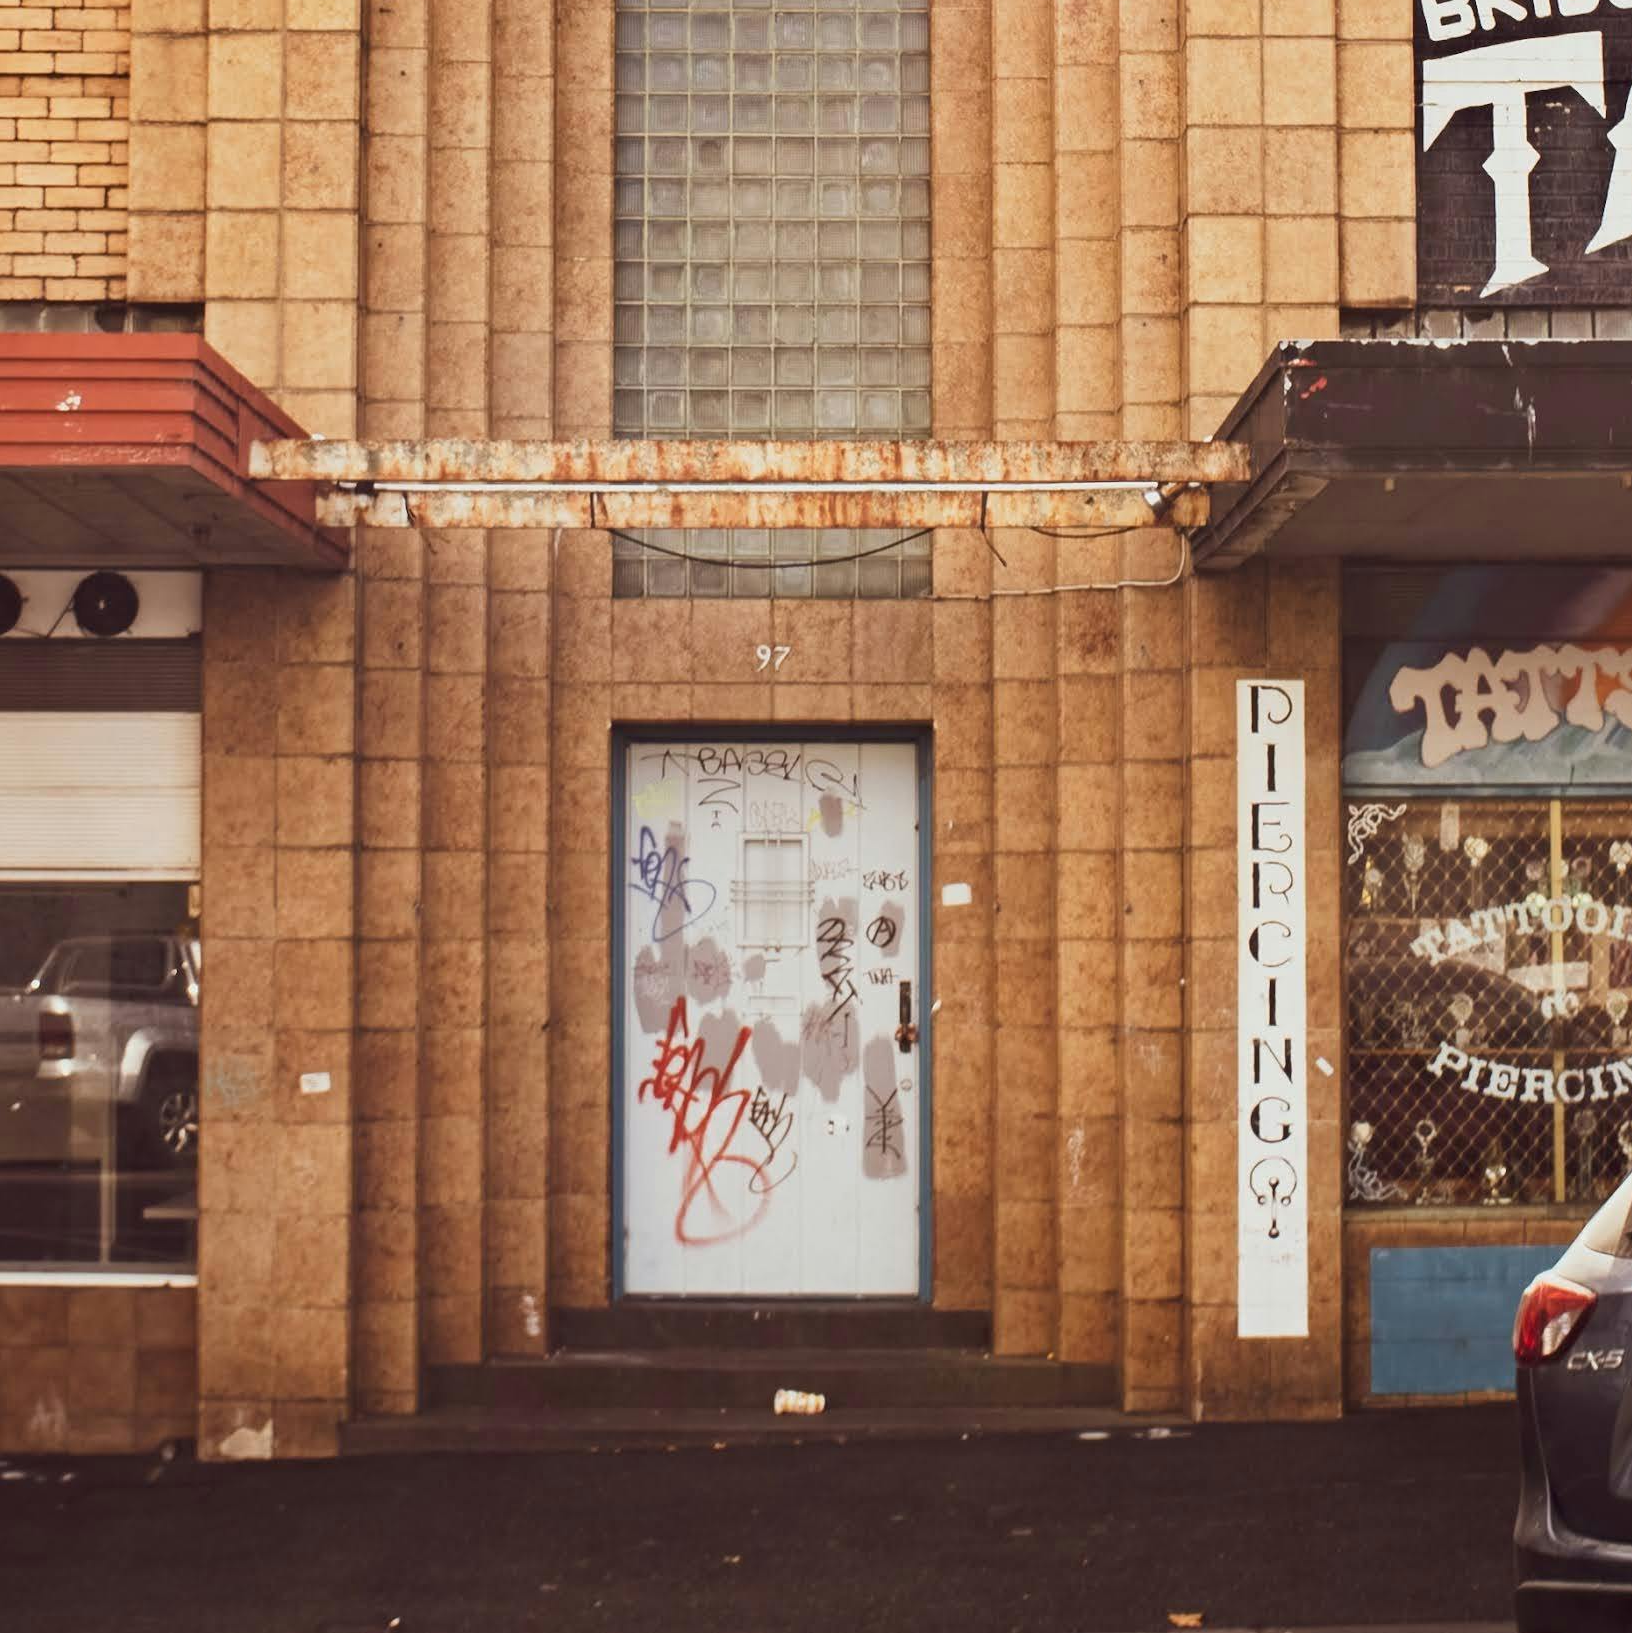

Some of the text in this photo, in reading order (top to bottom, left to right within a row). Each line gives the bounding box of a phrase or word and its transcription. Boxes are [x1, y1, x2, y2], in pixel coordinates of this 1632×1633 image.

[755, 644, 792, 673] 97
[1247, 684, 1294, 1144] PIERCING
[1540, 990, 1580, 1020] &
[1567, 1349, 1625, 1371] CX-5
